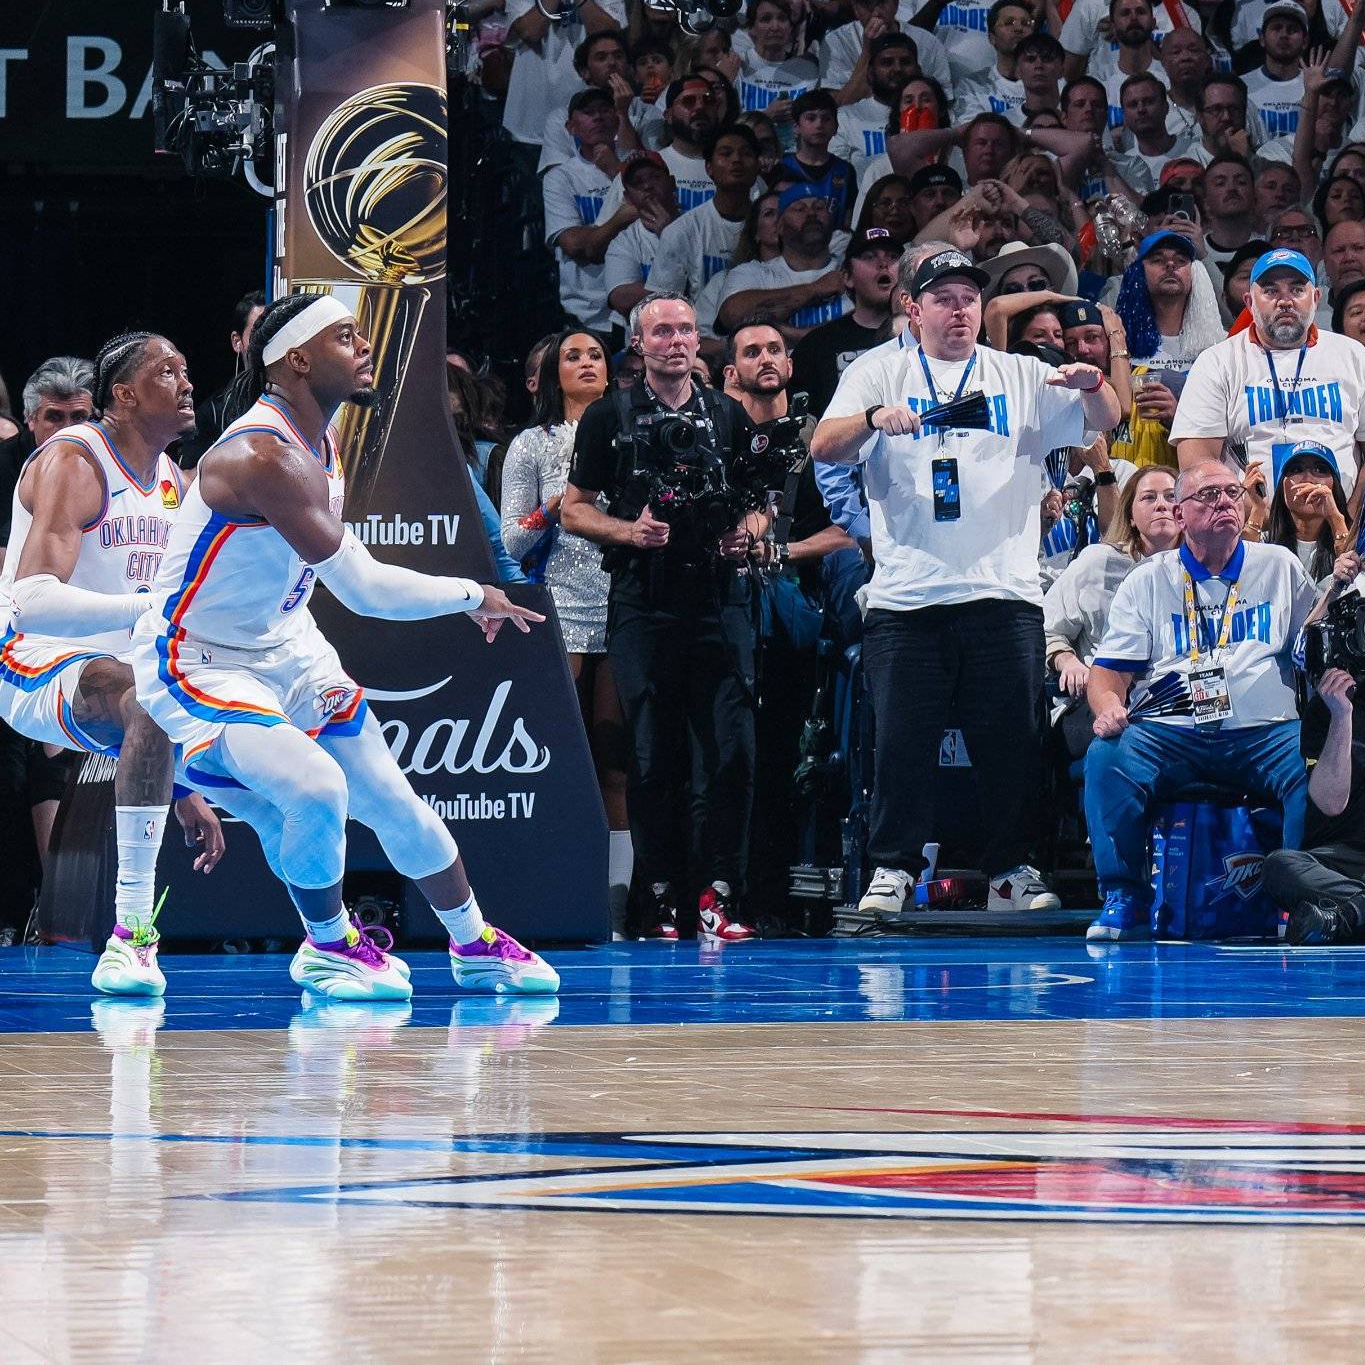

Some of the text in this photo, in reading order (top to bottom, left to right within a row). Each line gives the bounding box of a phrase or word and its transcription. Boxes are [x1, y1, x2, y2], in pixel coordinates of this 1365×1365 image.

[1245, 382, 1343, 426] THUNDER
[343, 514, 461, 546] ouTube TV
[280, 564, 315, 617] 5
[508, 791, 536, 819] TV
